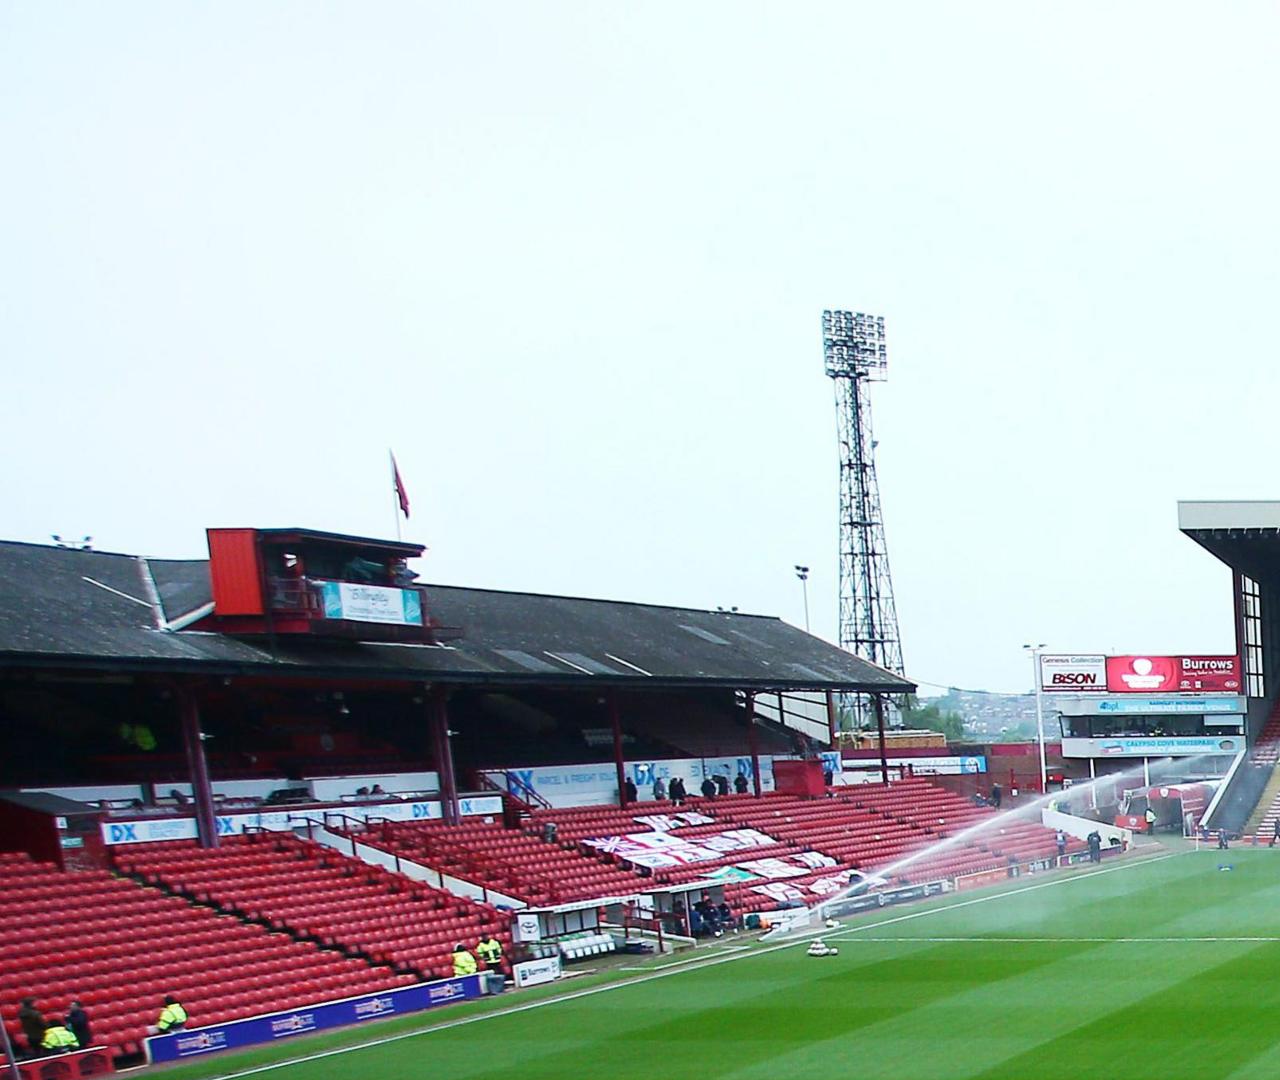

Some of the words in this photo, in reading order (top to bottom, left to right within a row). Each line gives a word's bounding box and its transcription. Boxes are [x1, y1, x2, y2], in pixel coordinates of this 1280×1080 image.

[1182, 658, 1233, 669] Burrows
[413, 804, 430, 818] DX
[110, 823, 138, 842] DX
